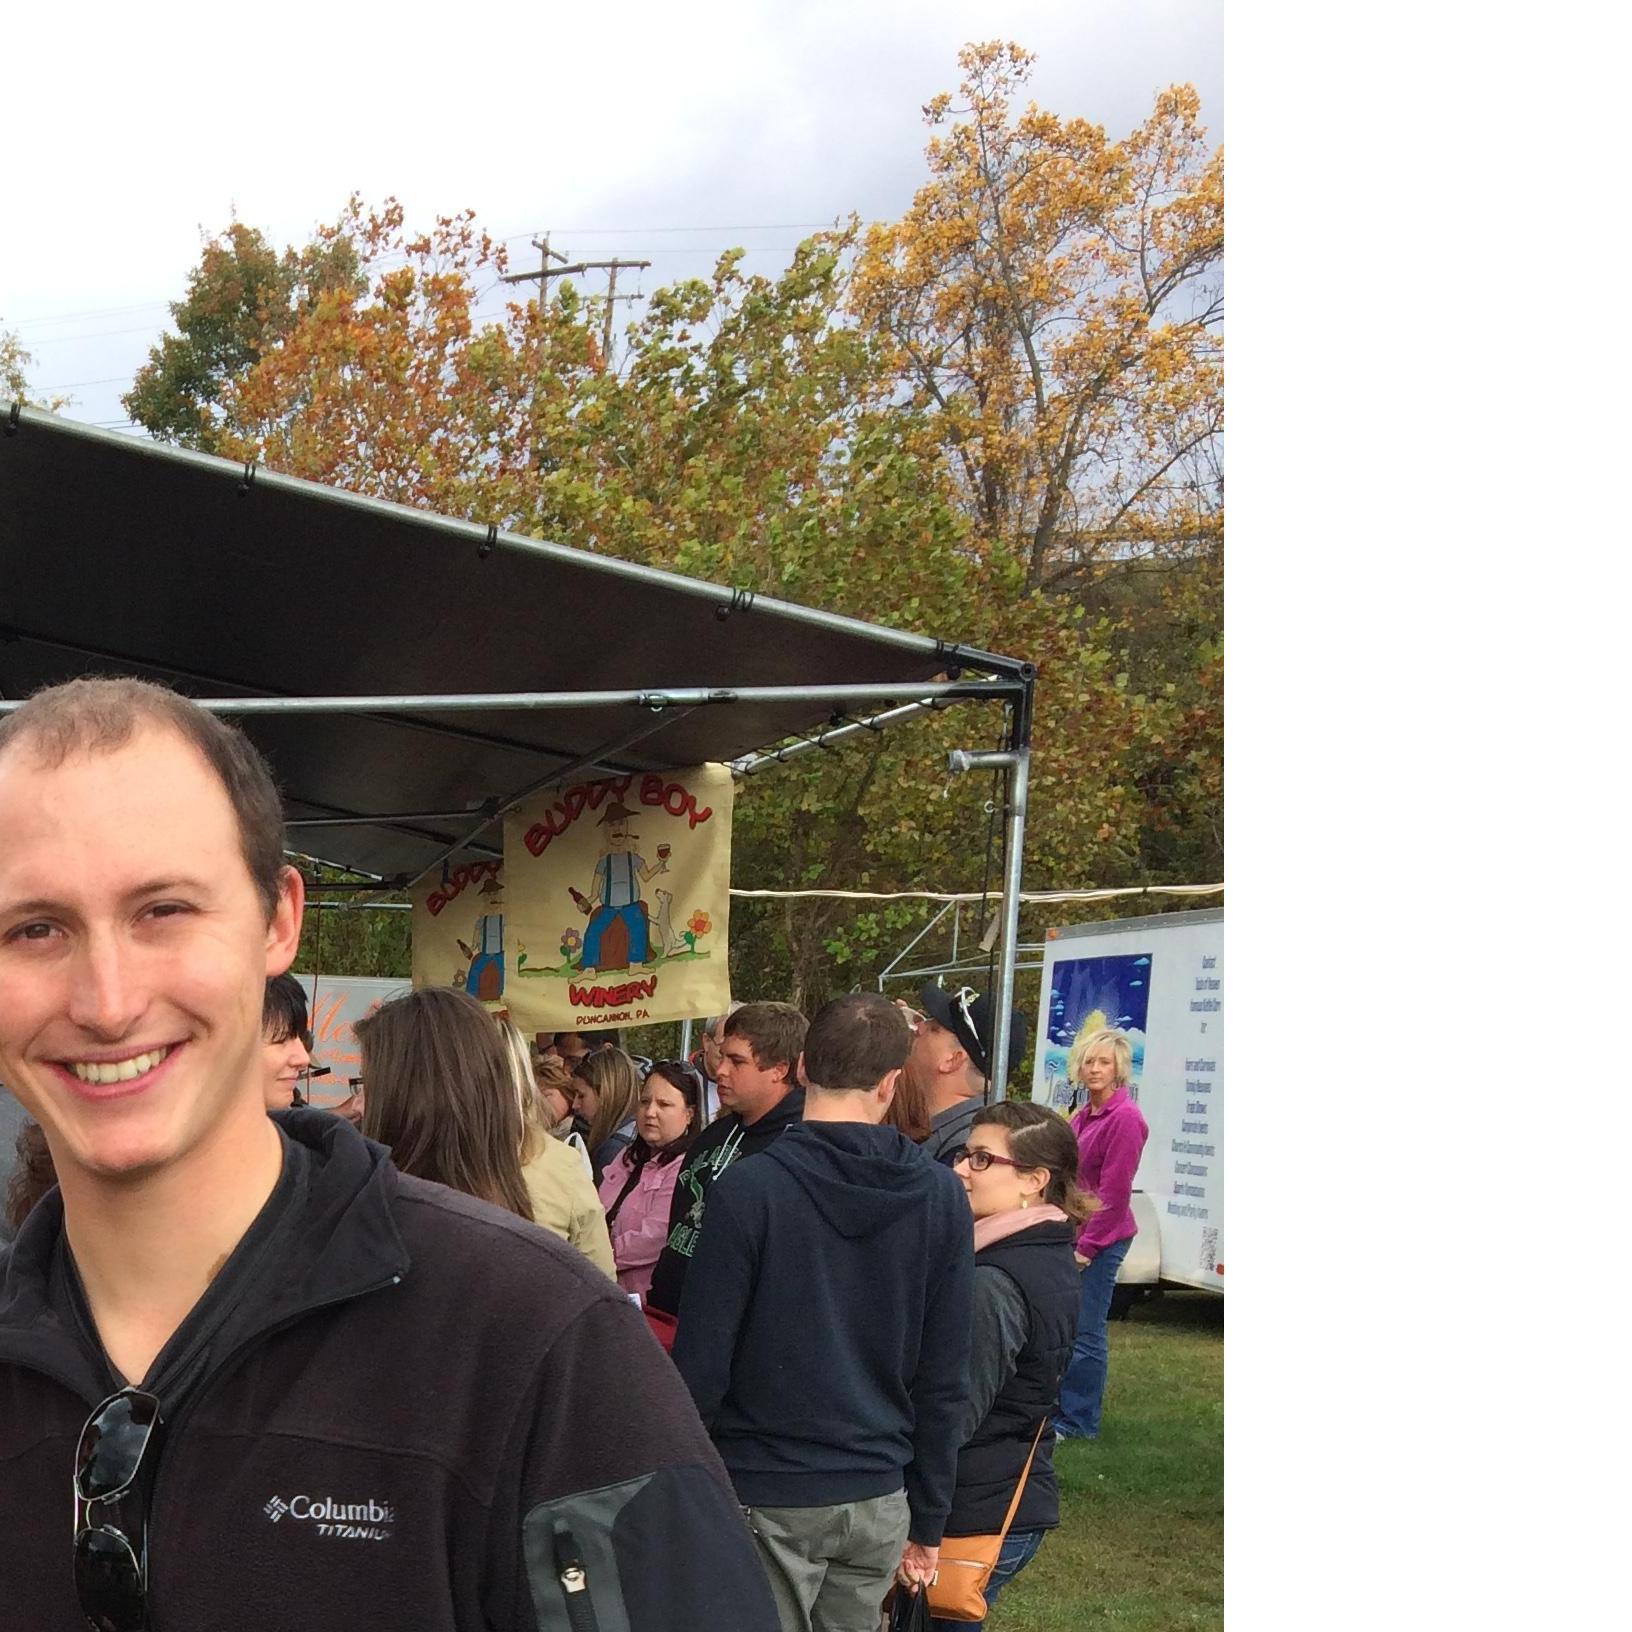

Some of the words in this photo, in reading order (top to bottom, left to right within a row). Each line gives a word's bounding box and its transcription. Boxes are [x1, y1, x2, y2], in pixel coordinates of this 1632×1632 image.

[524, 774, 632, 857] BUDDY
[639, 774, 712, 829] BOY
[569, 975, 657, 1007] WINERY
[636, 1010, 650, 1020] PA
